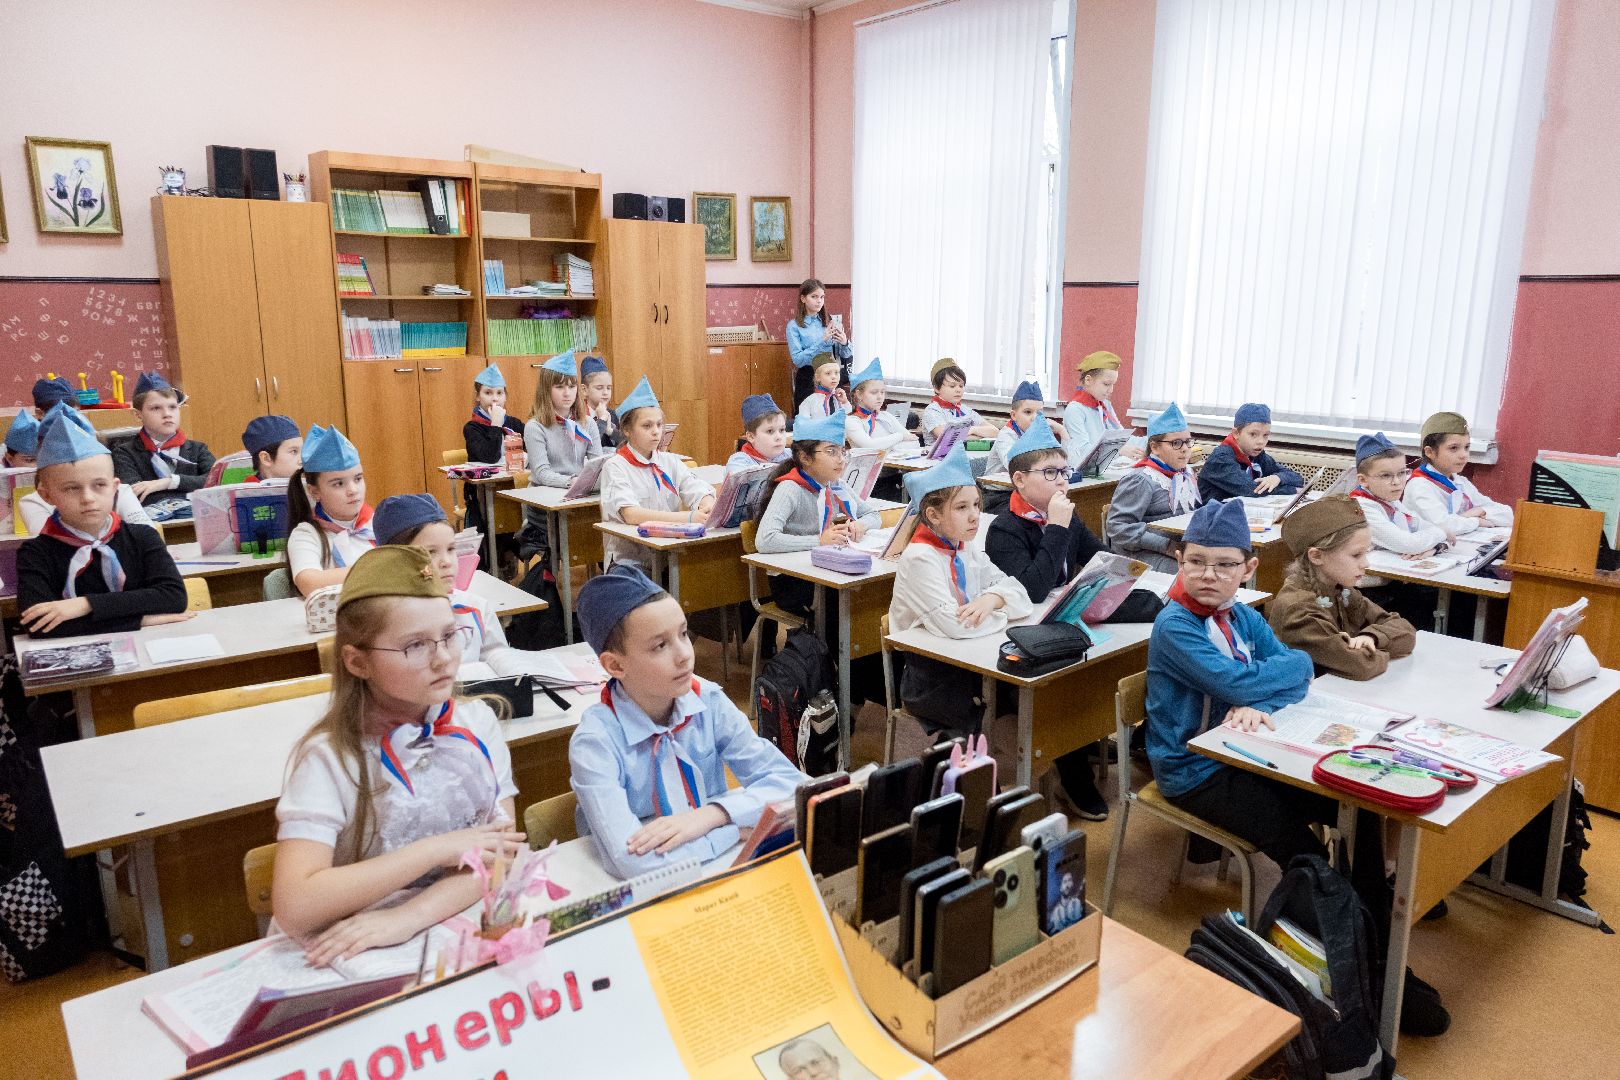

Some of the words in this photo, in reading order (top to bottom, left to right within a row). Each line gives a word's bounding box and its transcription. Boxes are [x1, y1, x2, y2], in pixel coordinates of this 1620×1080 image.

[97, 290, 106, 299] 2
[108, 294, 116, 302] 3
[82, 308, 89, 316] 9
[106, 304, 114, 312] 7
[275, 968, 611, 1080] ионеры-
